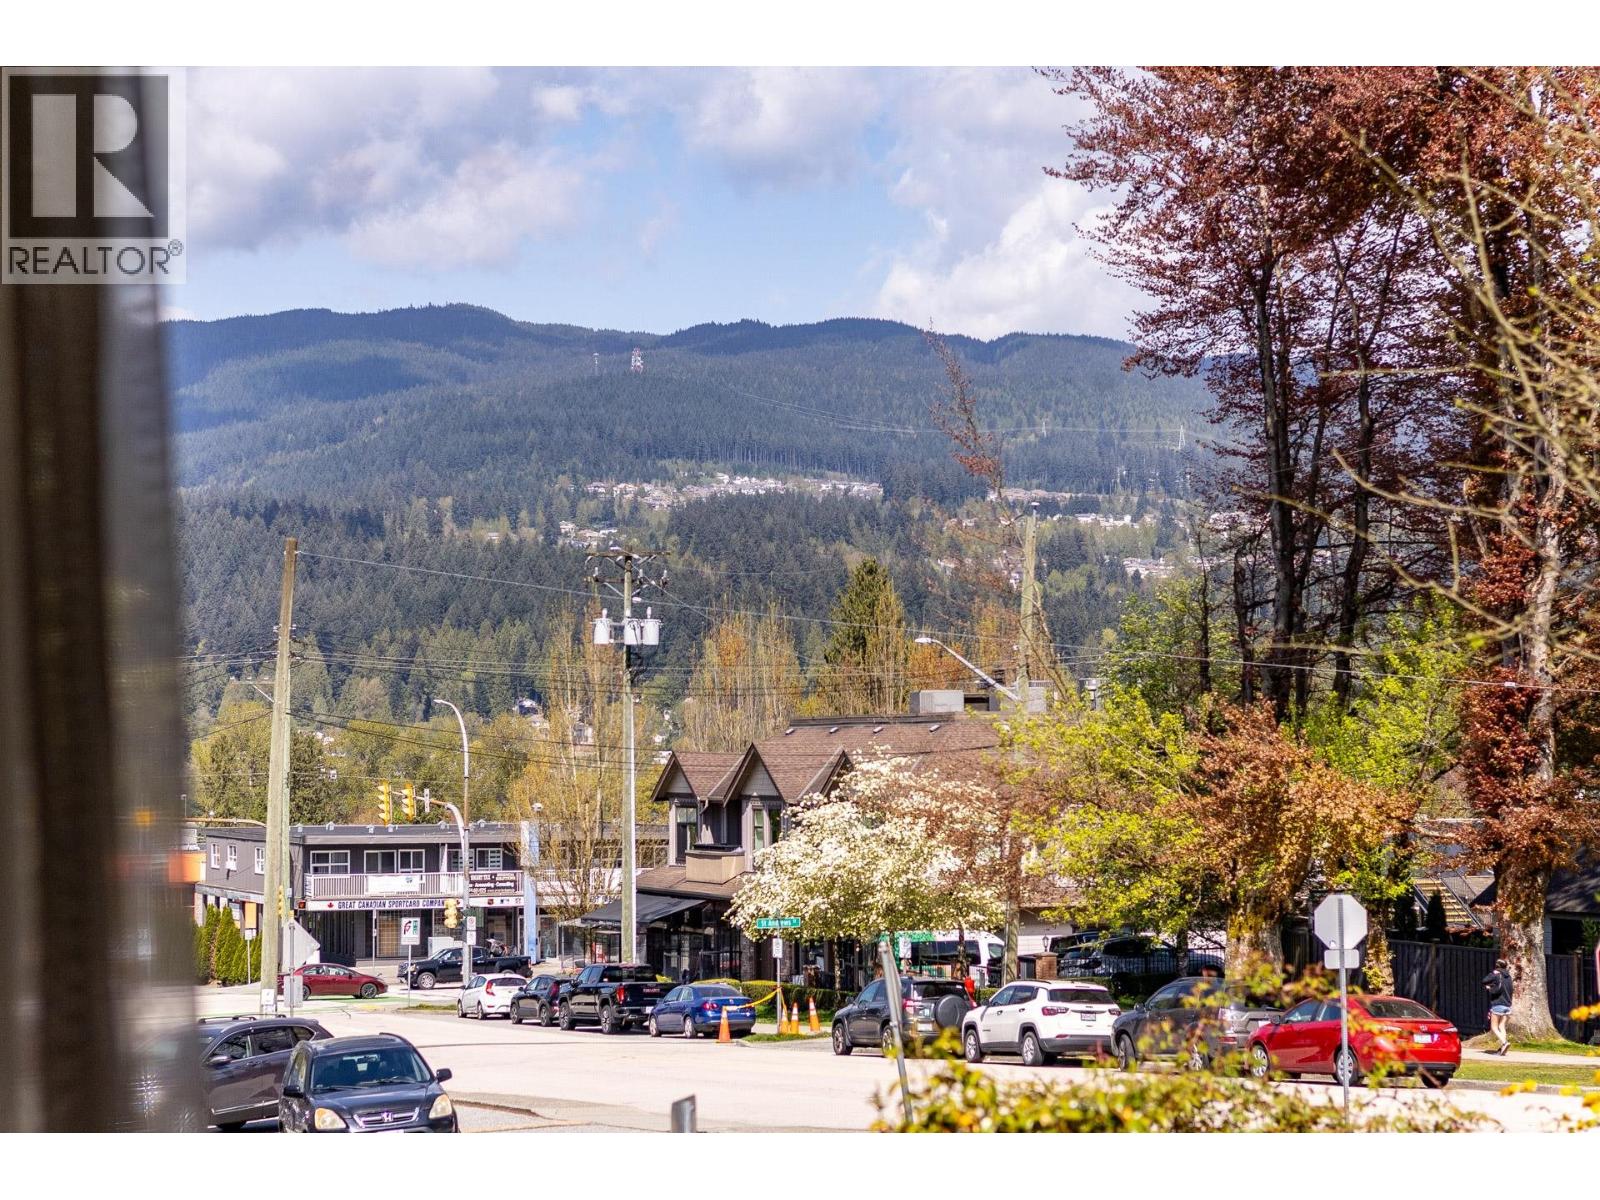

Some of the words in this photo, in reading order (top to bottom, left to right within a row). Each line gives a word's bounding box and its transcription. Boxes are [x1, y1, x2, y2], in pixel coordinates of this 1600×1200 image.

[338, 901, 356, 909] GREAT
[357, 900, 386, 909] CANADIAN
[388, 900, 420, 908] SPORTCARD
[422, 899, 445, 908] COMPAN
